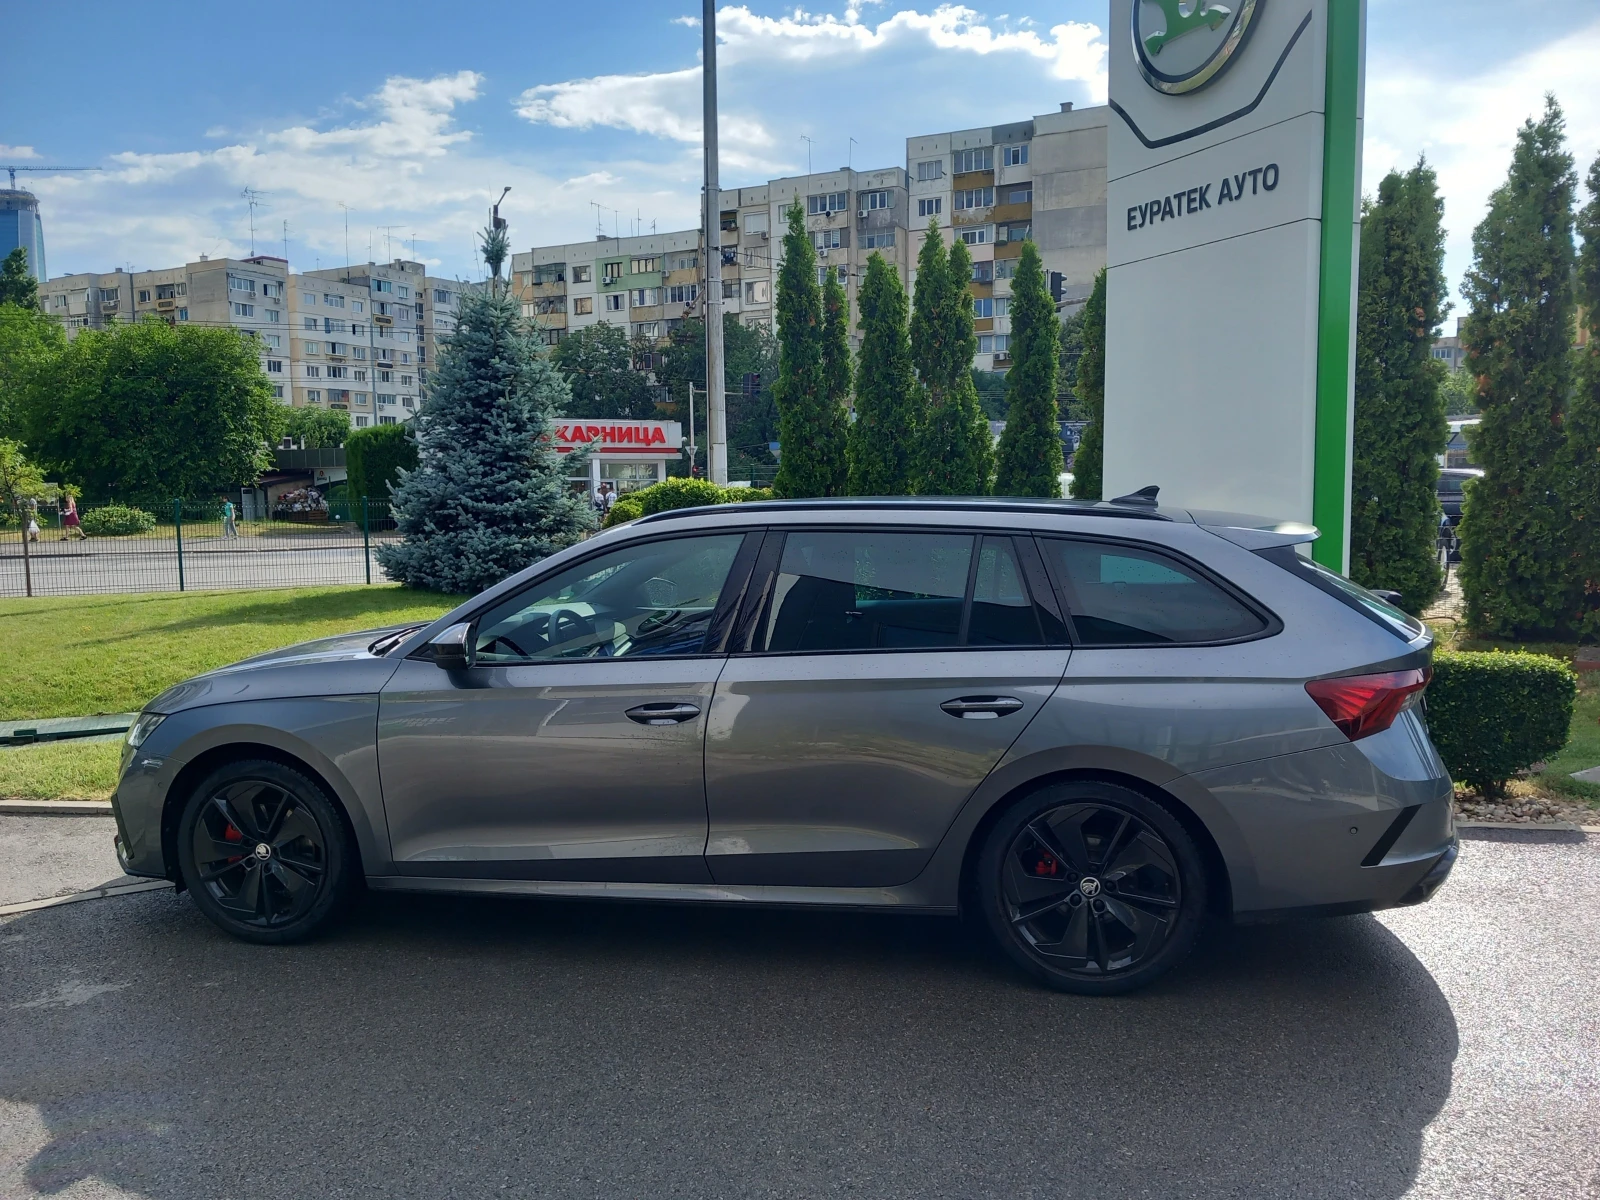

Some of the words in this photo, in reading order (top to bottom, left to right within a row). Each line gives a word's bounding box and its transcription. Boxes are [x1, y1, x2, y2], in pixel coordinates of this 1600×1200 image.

[1127, 183, 1212, 231] ЕУРАТЕК
[1217, 163, 1280, 205] АУТО
[541, 425, 666, 446] КАРНИЦА
